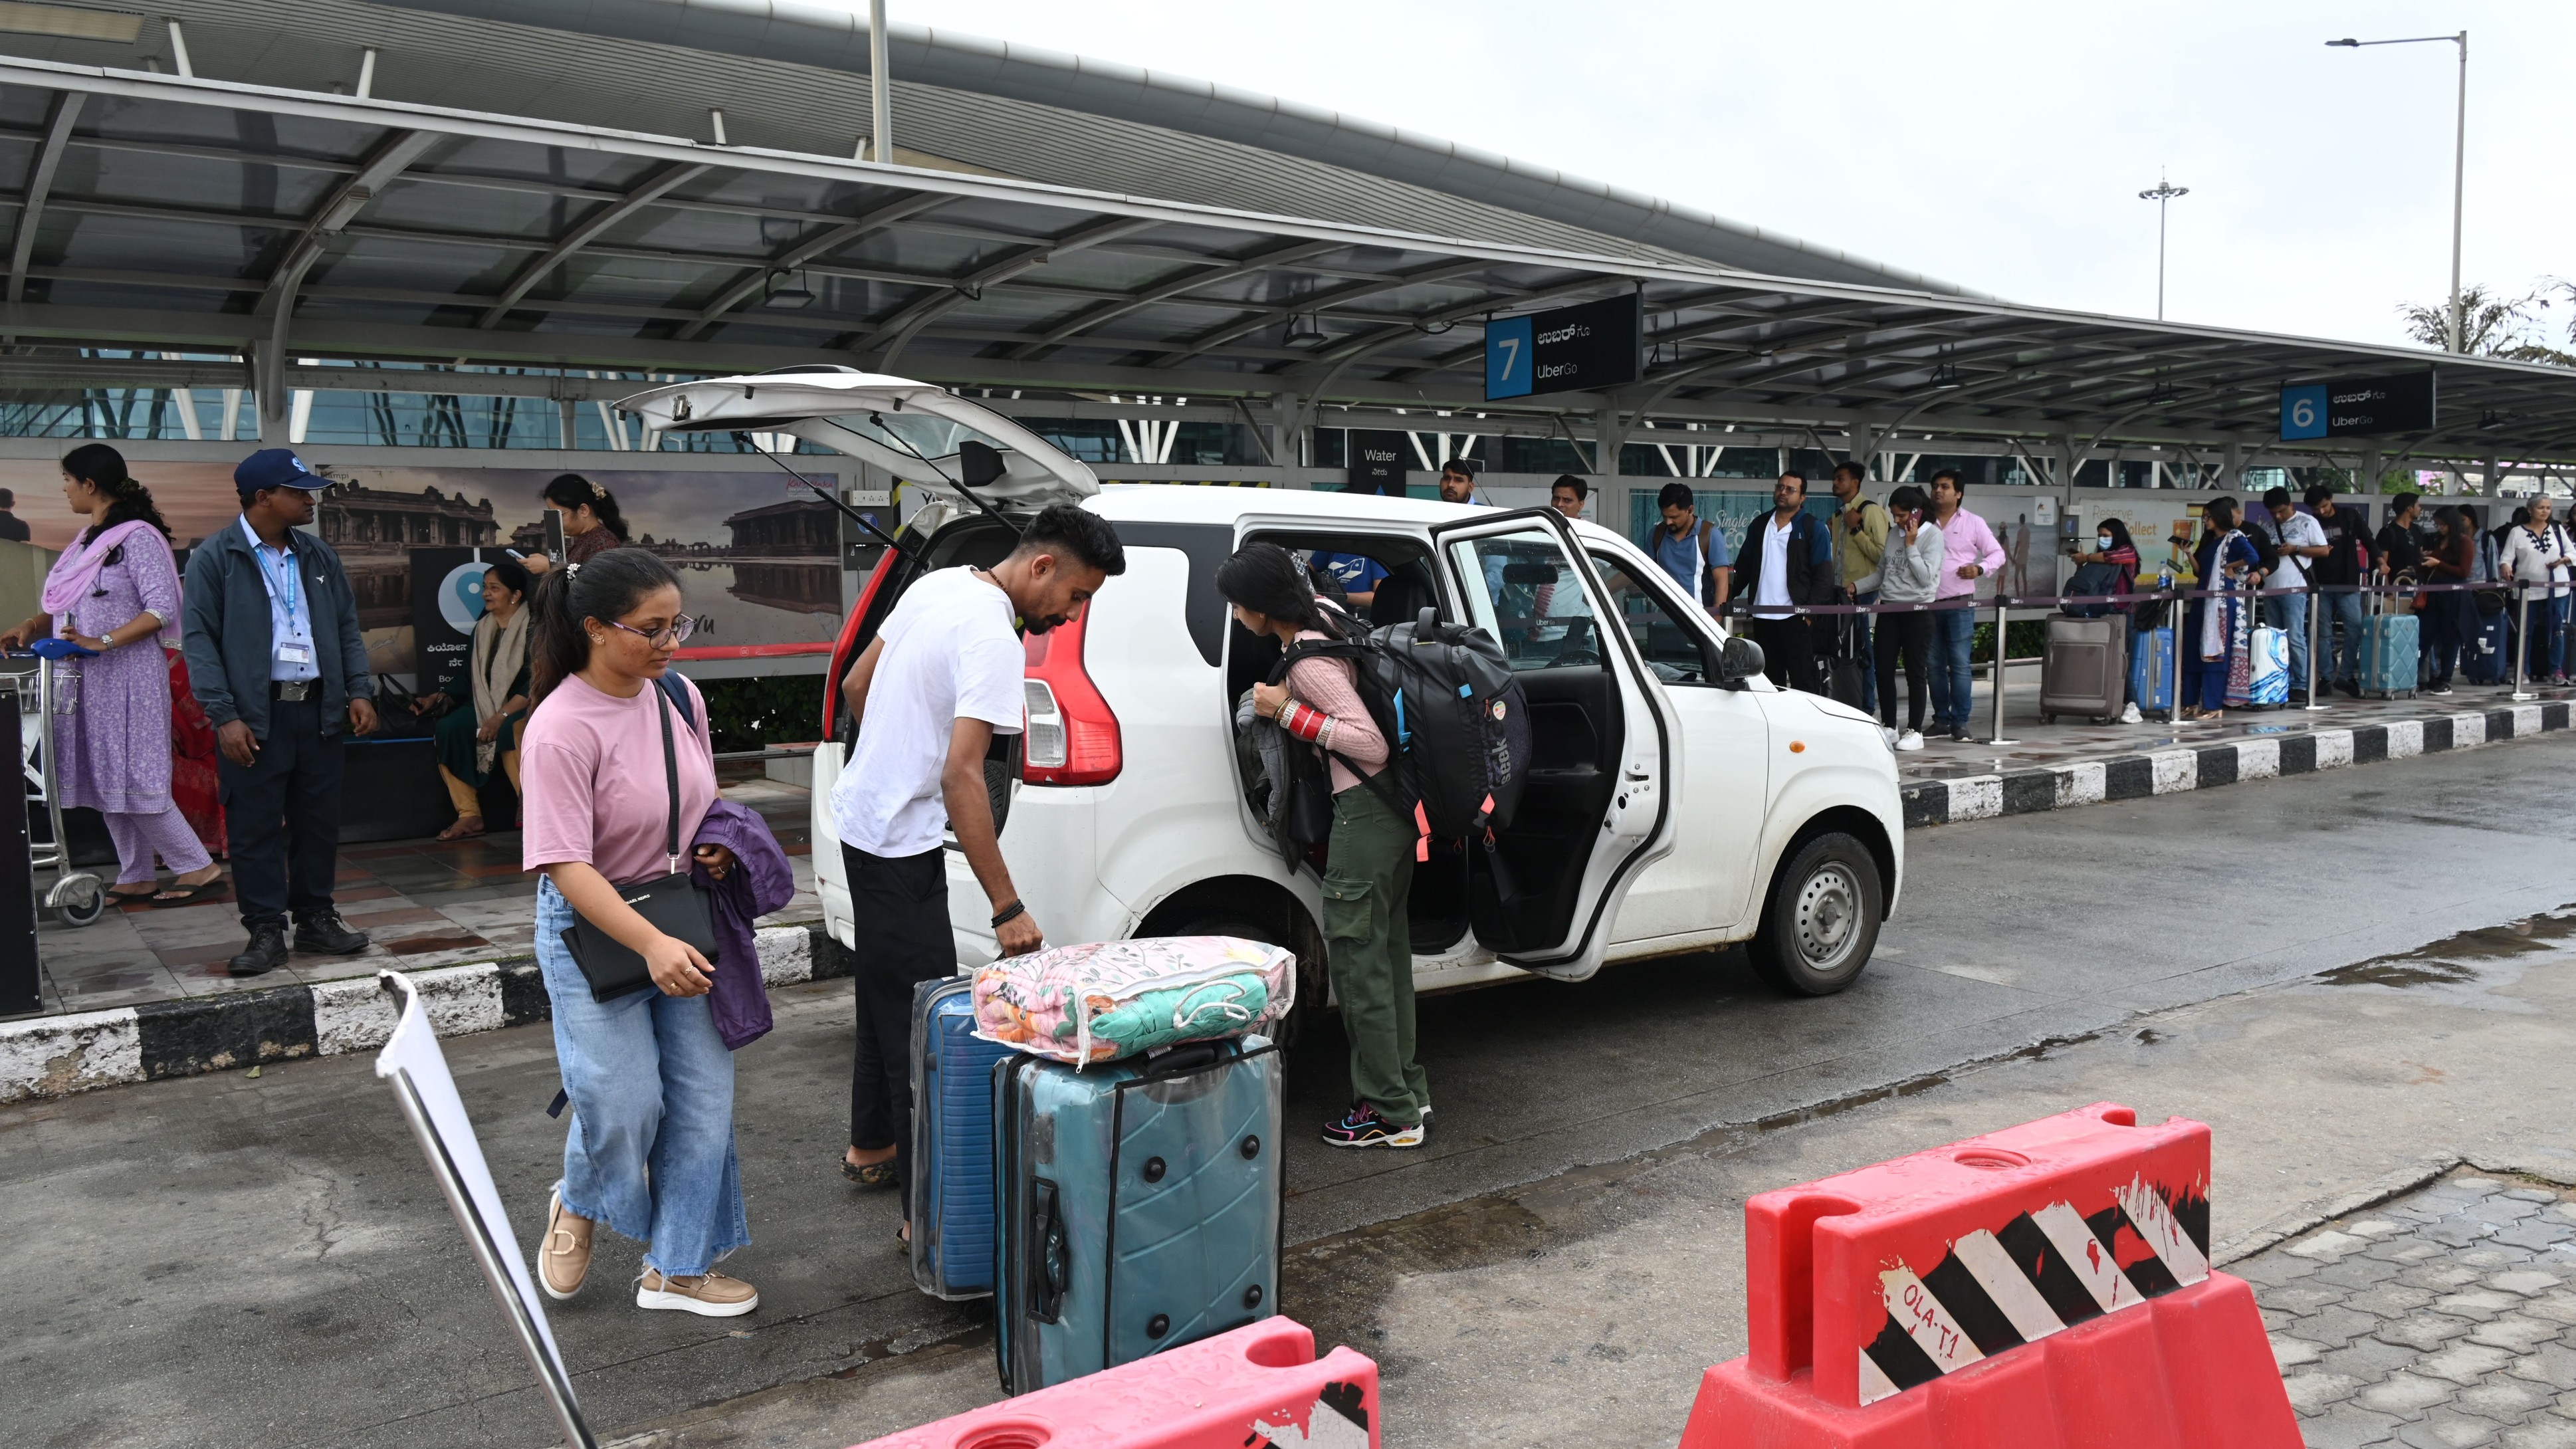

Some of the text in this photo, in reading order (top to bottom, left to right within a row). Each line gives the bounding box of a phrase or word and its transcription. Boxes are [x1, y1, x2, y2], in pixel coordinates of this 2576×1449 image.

[1537, 324, 1575, 345] ಉಬರ್
[1499, 338, 1519, 381] 7
[2333, 390, 2371, 404] ಉಬರ್
[2292, 398, 2314, 427] 6
[1364, 449, 1396, 461] Water
[1716, 510, 1748, 534] Single
[2093, 505, 2133, 520] Reserve
[1491, 737, 1511, 785] seek
